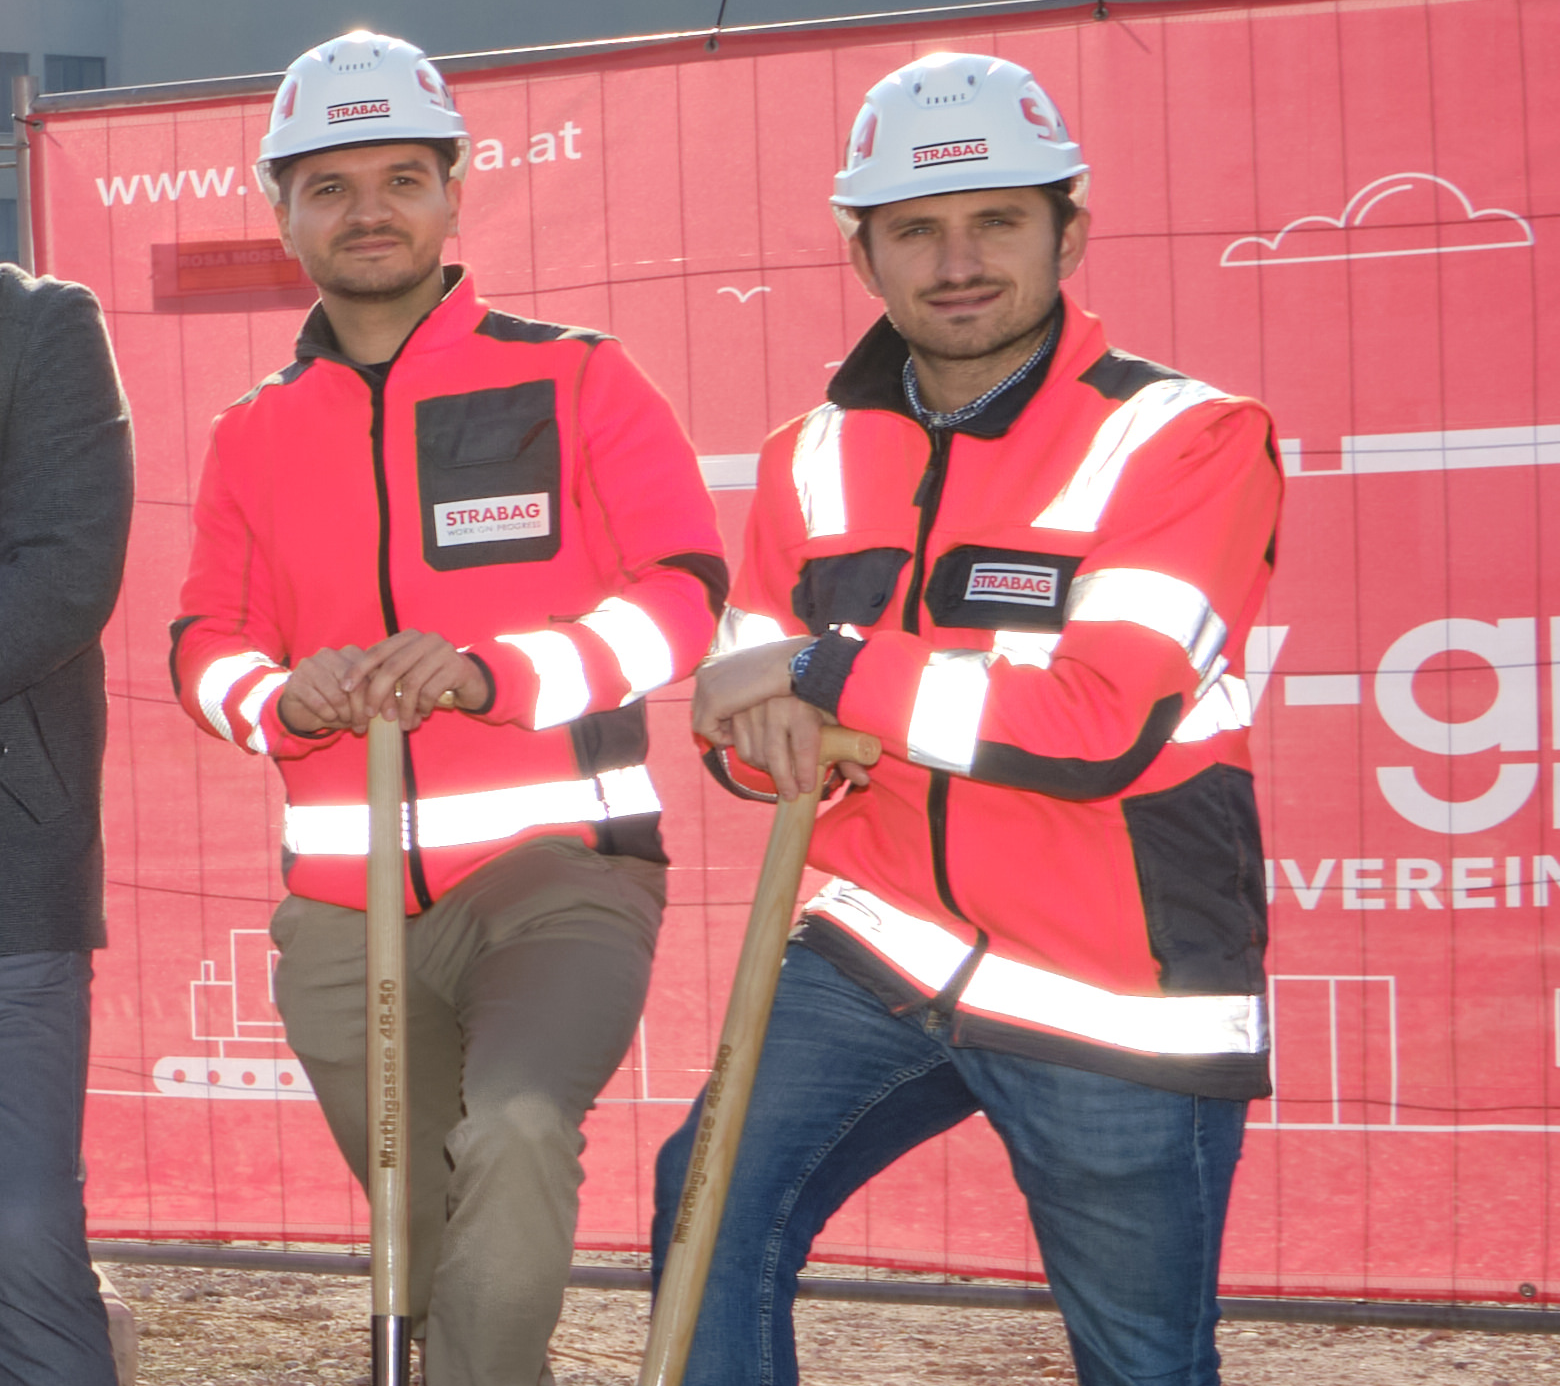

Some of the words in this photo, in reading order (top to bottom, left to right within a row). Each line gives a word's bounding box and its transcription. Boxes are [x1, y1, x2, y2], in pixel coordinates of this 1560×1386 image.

[328, 102, 391, 120] STRABAG
[913, 142, 989, 163] STRABAG
[446, 503, 540, 526] STRABAG
[972, 575, 1051, 593] STRABAG
[378, 979, 396, 1040] 48-50
[379, 1046, 399, 1169] Muthgasse
[672, 1115, 715, 1244] Muthgasse
